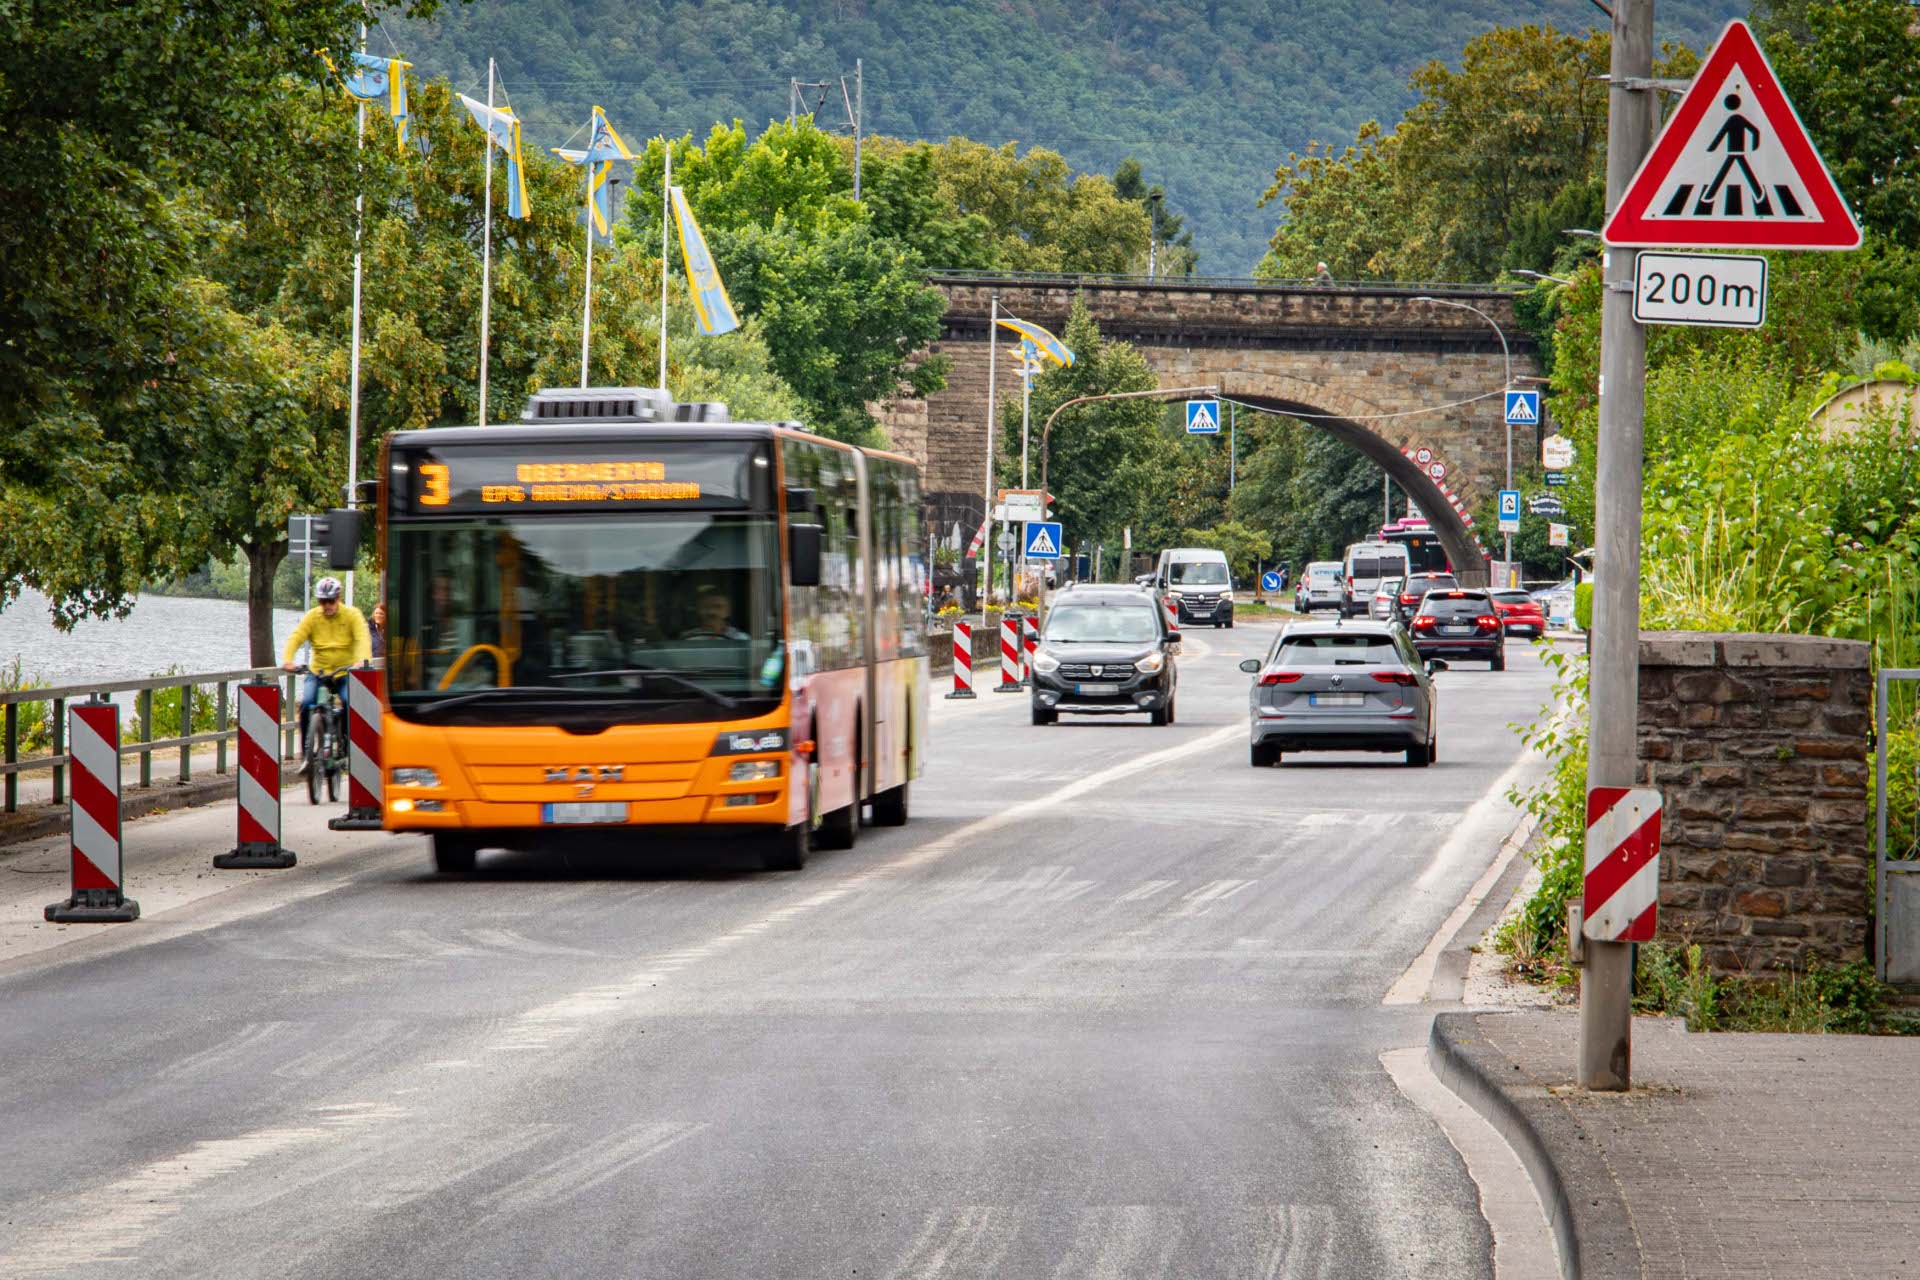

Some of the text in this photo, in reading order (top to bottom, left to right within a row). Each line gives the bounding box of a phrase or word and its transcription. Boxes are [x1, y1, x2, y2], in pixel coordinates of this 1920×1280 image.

[1645, 271, 1755, 308] 200m
[419, 464, 449, 505] 3
[544, 764, 626, 782] MAN
